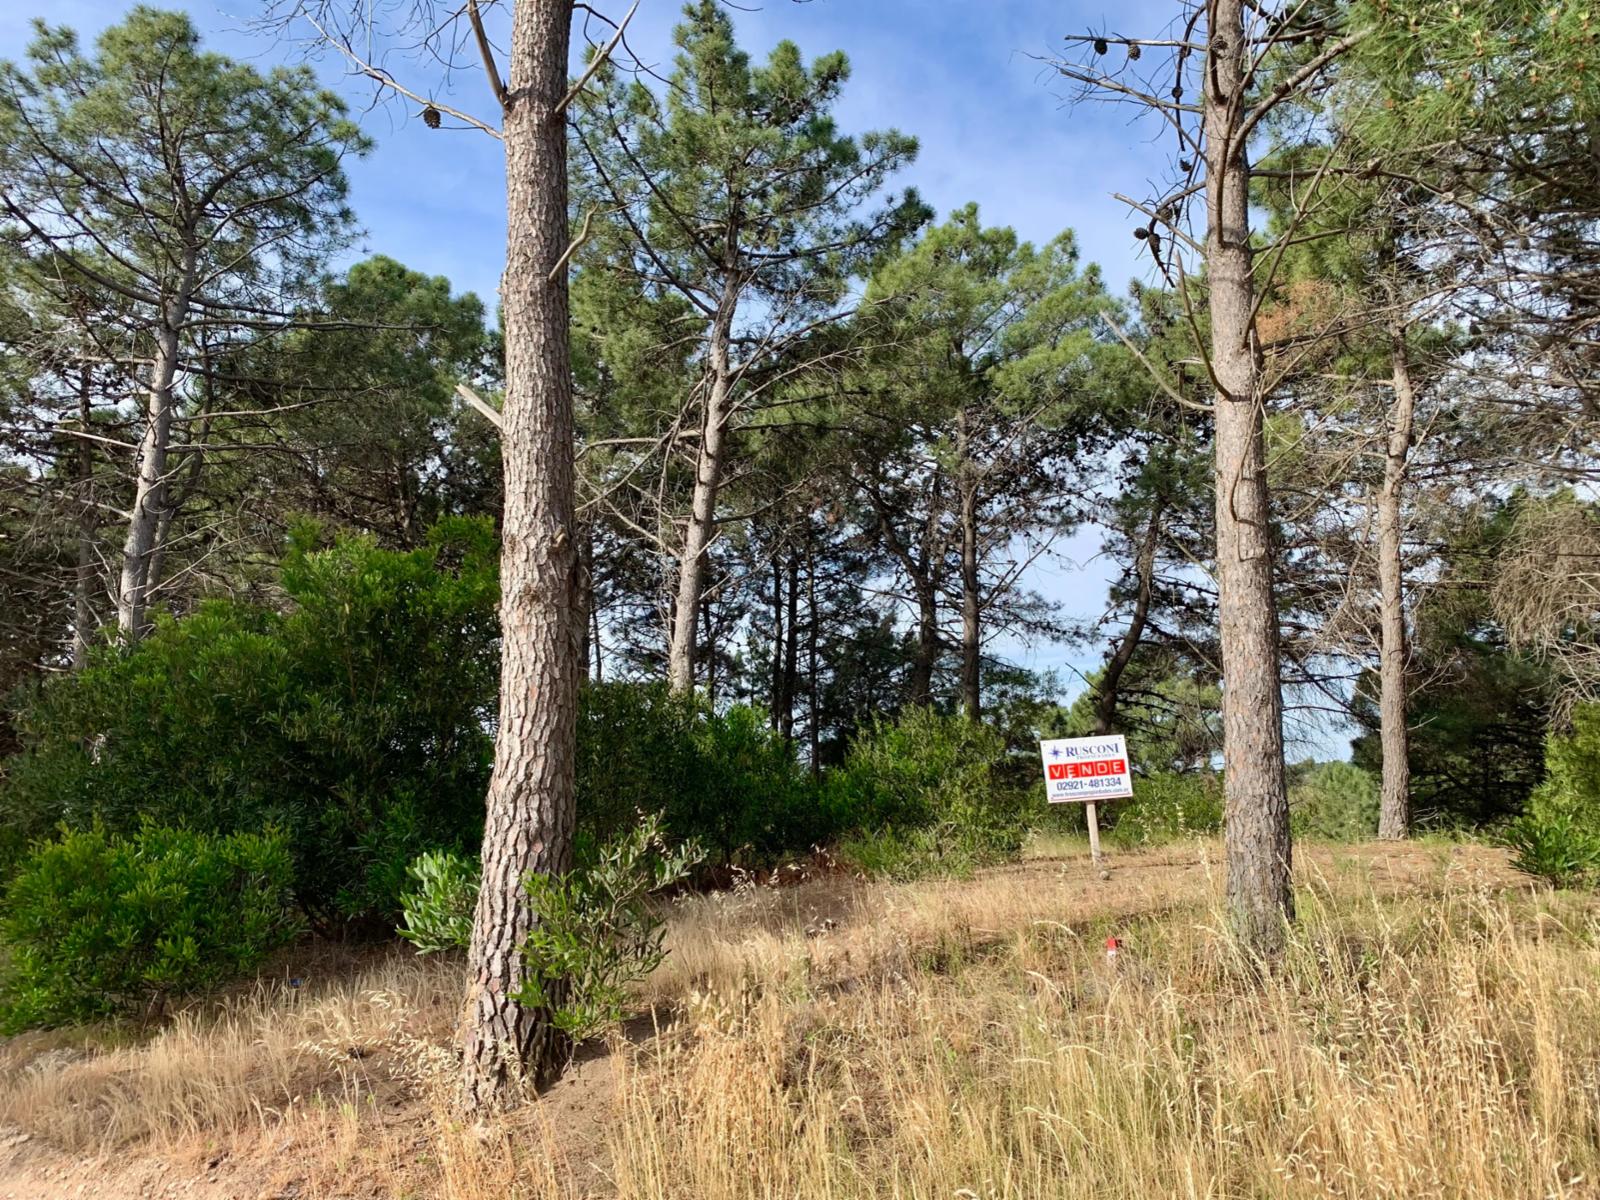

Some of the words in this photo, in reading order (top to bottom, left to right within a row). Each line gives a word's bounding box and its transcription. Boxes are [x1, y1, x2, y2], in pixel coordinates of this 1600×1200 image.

[1066, 743, 1119, 757] RUSCONI
[1051, 761, 1122, 778] VENDE
[1057, 777, 1122, 791] 02921-481334
